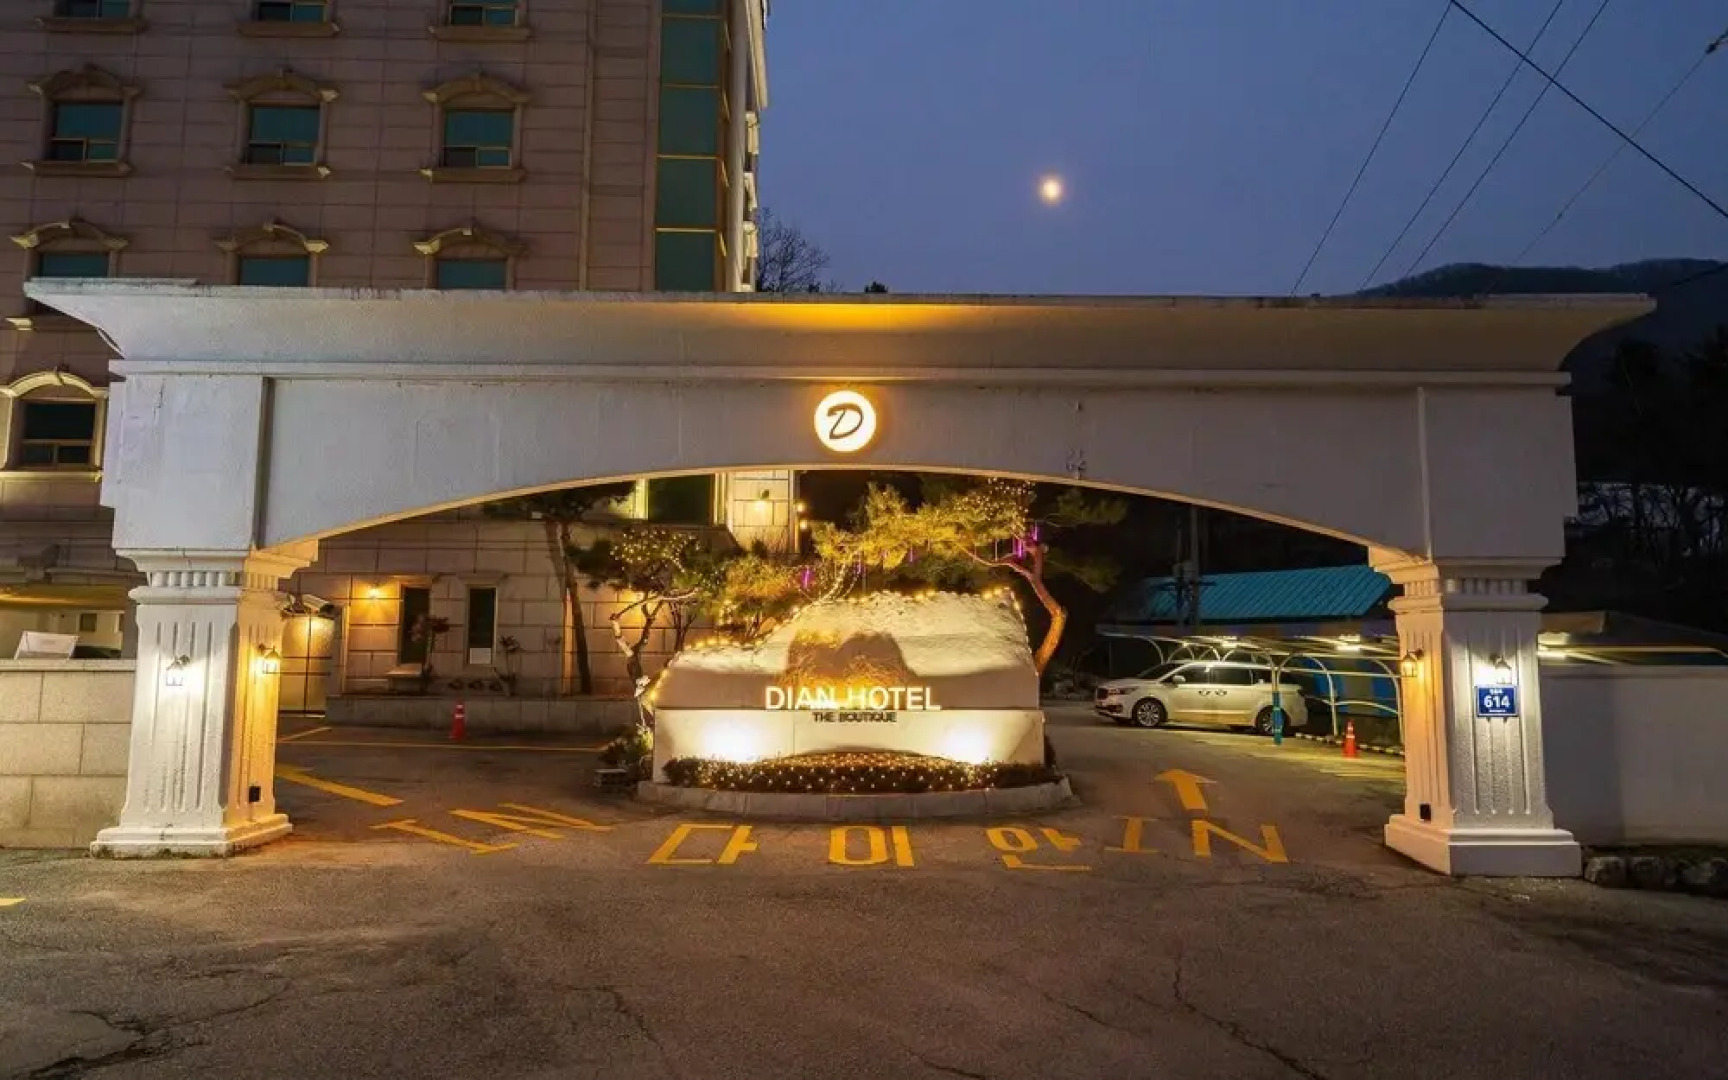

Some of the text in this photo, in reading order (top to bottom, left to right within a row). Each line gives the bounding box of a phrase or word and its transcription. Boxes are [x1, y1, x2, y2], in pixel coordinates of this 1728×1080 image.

[827, 402, 864, 440] D
[765, 686, 942, 711] DIAN HOTEL
[1483, 694, 1511, 708] 614
[812, 711, 897, 723] THE BOUTIQUE
[1103, 815, 1289, 864] IN
